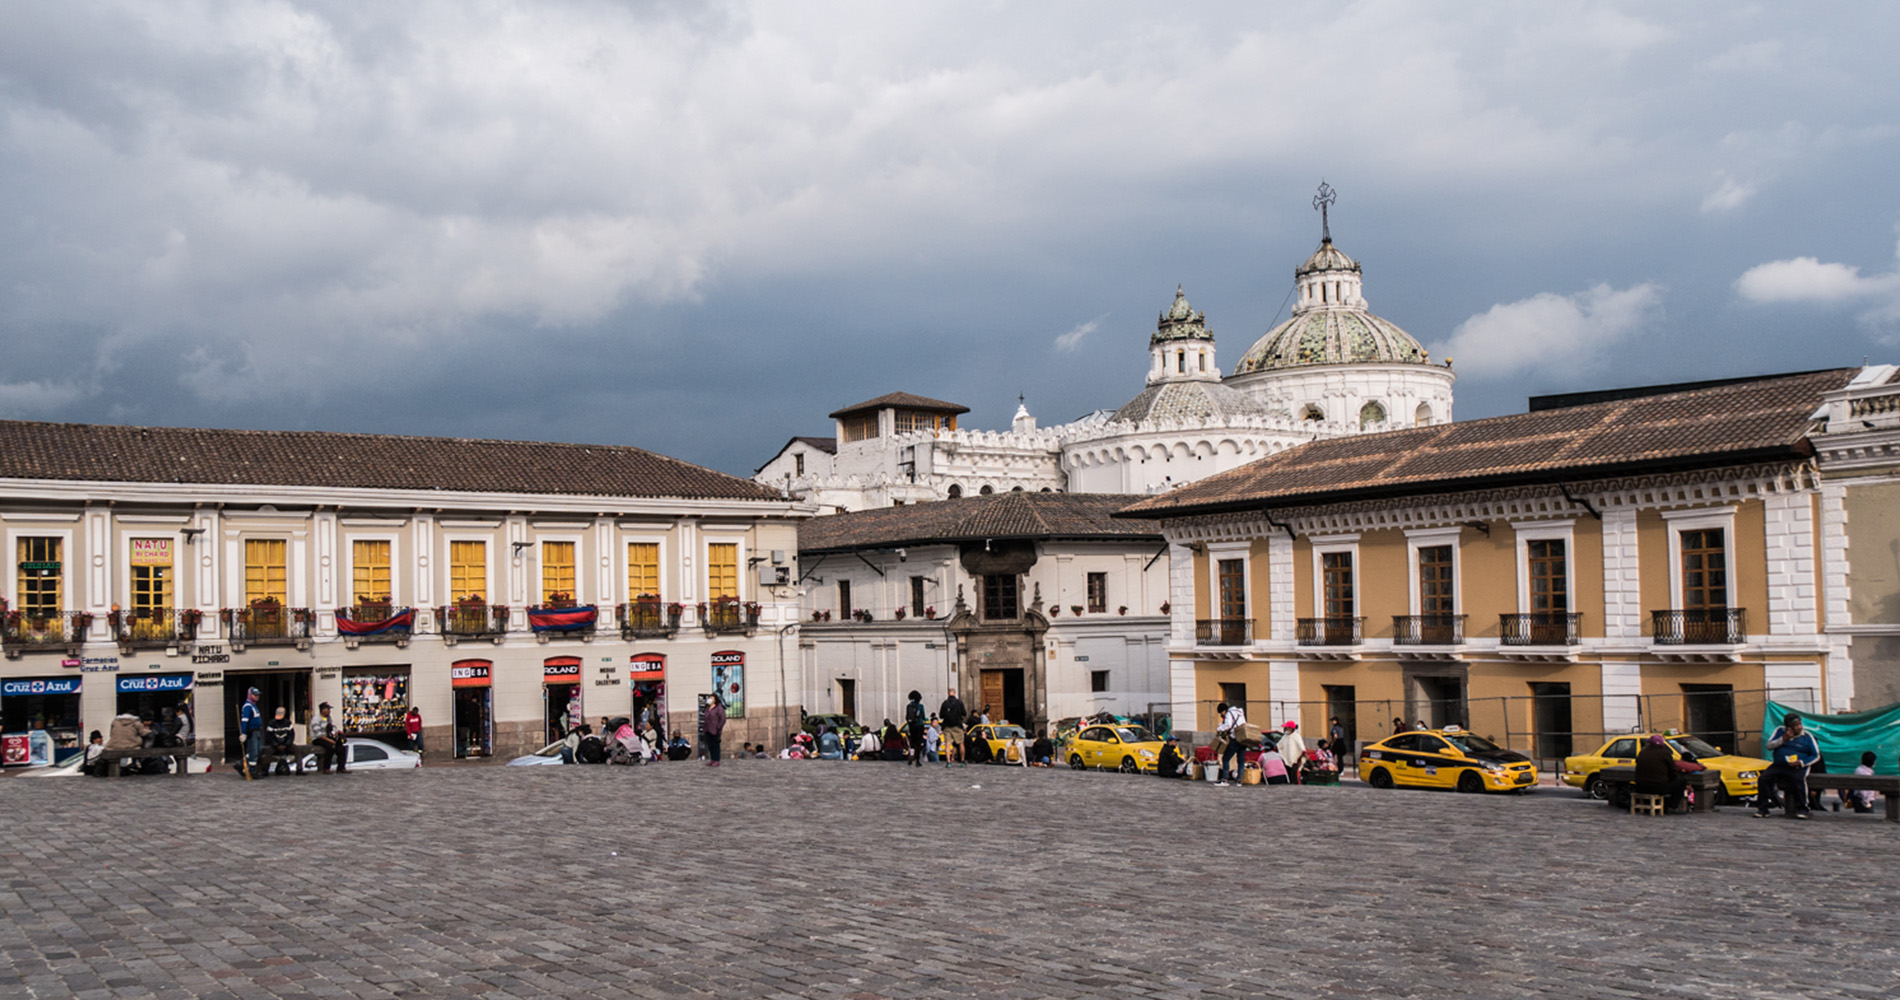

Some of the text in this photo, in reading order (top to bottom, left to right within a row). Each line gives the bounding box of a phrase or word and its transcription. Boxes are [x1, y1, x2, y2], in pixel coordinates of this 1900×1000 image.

[135, 540, 167, 550] NATU
[198, 645, 222, 654] NATU
[192, 654, 230, 664] RICHARD
[544, 666, 579, 674] ROLAND
[631, 662, 662, 670] INGESA
[454, 668, 488, 677] INGESA
[4, 681, 72, 693] Cruz Azul
[120, 677, 183, 690] Cruz Azul
